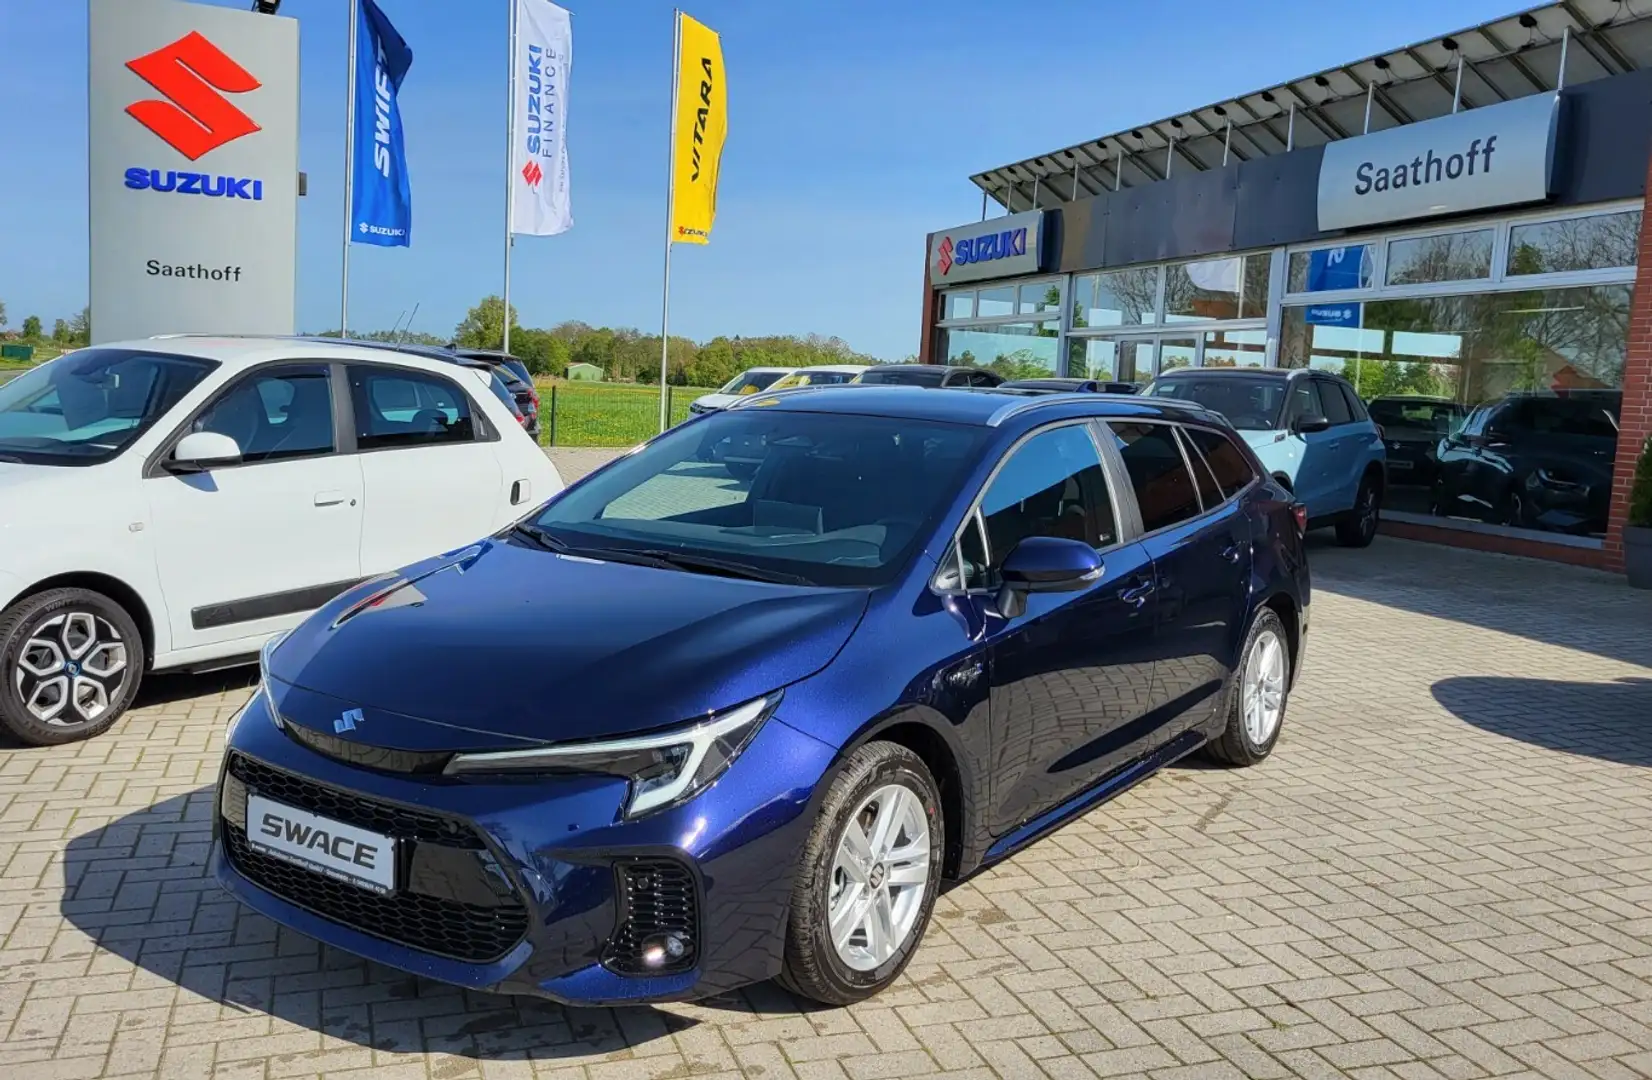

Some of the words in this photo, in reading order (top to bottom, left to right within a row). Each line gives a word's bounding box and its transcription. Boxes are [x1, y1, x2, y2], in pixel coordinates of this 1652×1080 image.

[374, 35, 391, 178] SWIFT
[527, 44, 542, 155] SUZUKI
[542, 48, 557, 158] FINANCE
[691, 57, 712, 182] VITARA
[124, 167, 263, 201] SUZUKI
[1355, 135, 1498, 196] Saathoff
[369, 225, 406, 236] SUZUKI
[955, 227, 1027, 266] SUZUKI
[146, 259, 242, 282] Saathoff
[260, 812, 378, 870] SWACE
